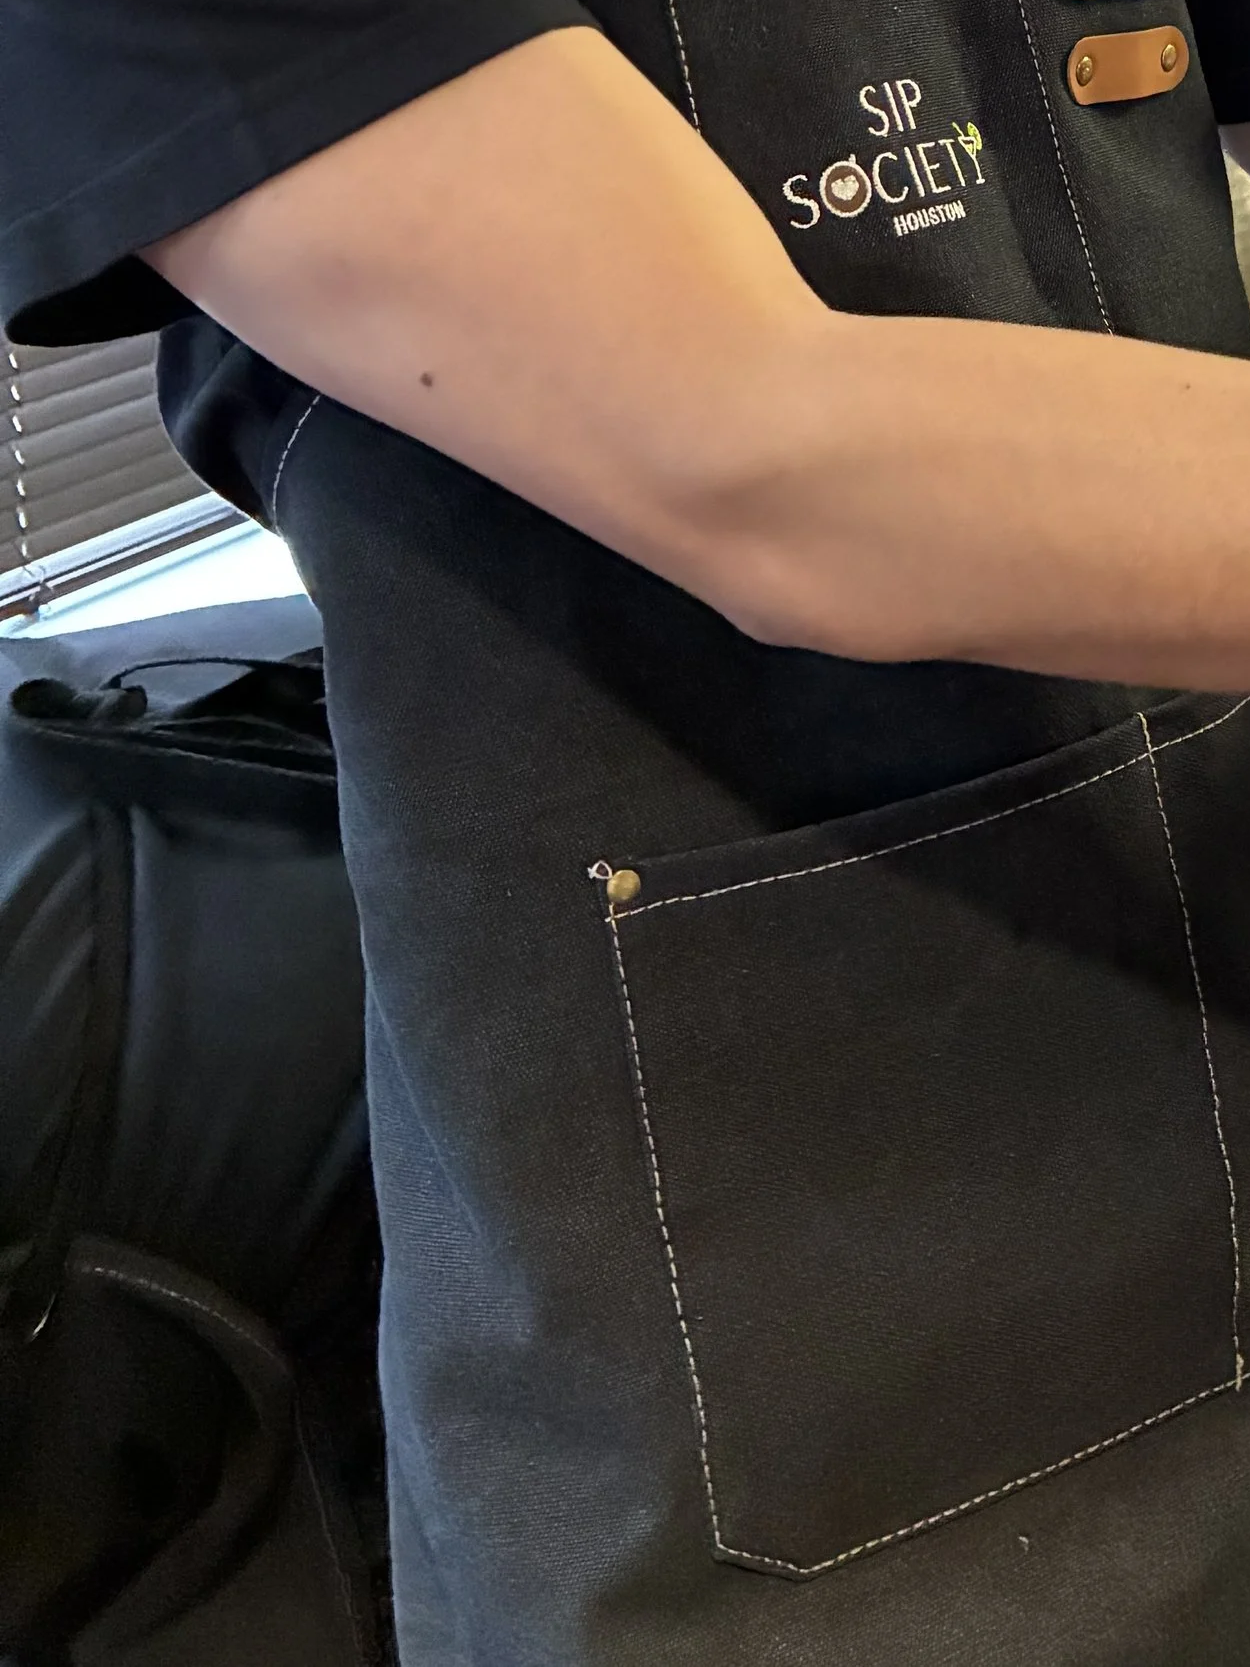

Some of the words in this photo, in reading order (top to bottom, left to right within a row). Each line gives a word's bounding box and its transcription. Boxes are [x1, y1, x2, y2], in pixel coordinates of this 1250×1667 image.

[859, 79, 922, 137] SIP
[782, 122, 986, 229] SOCIETY
[893, 200, 967, 237] HOUSTON
